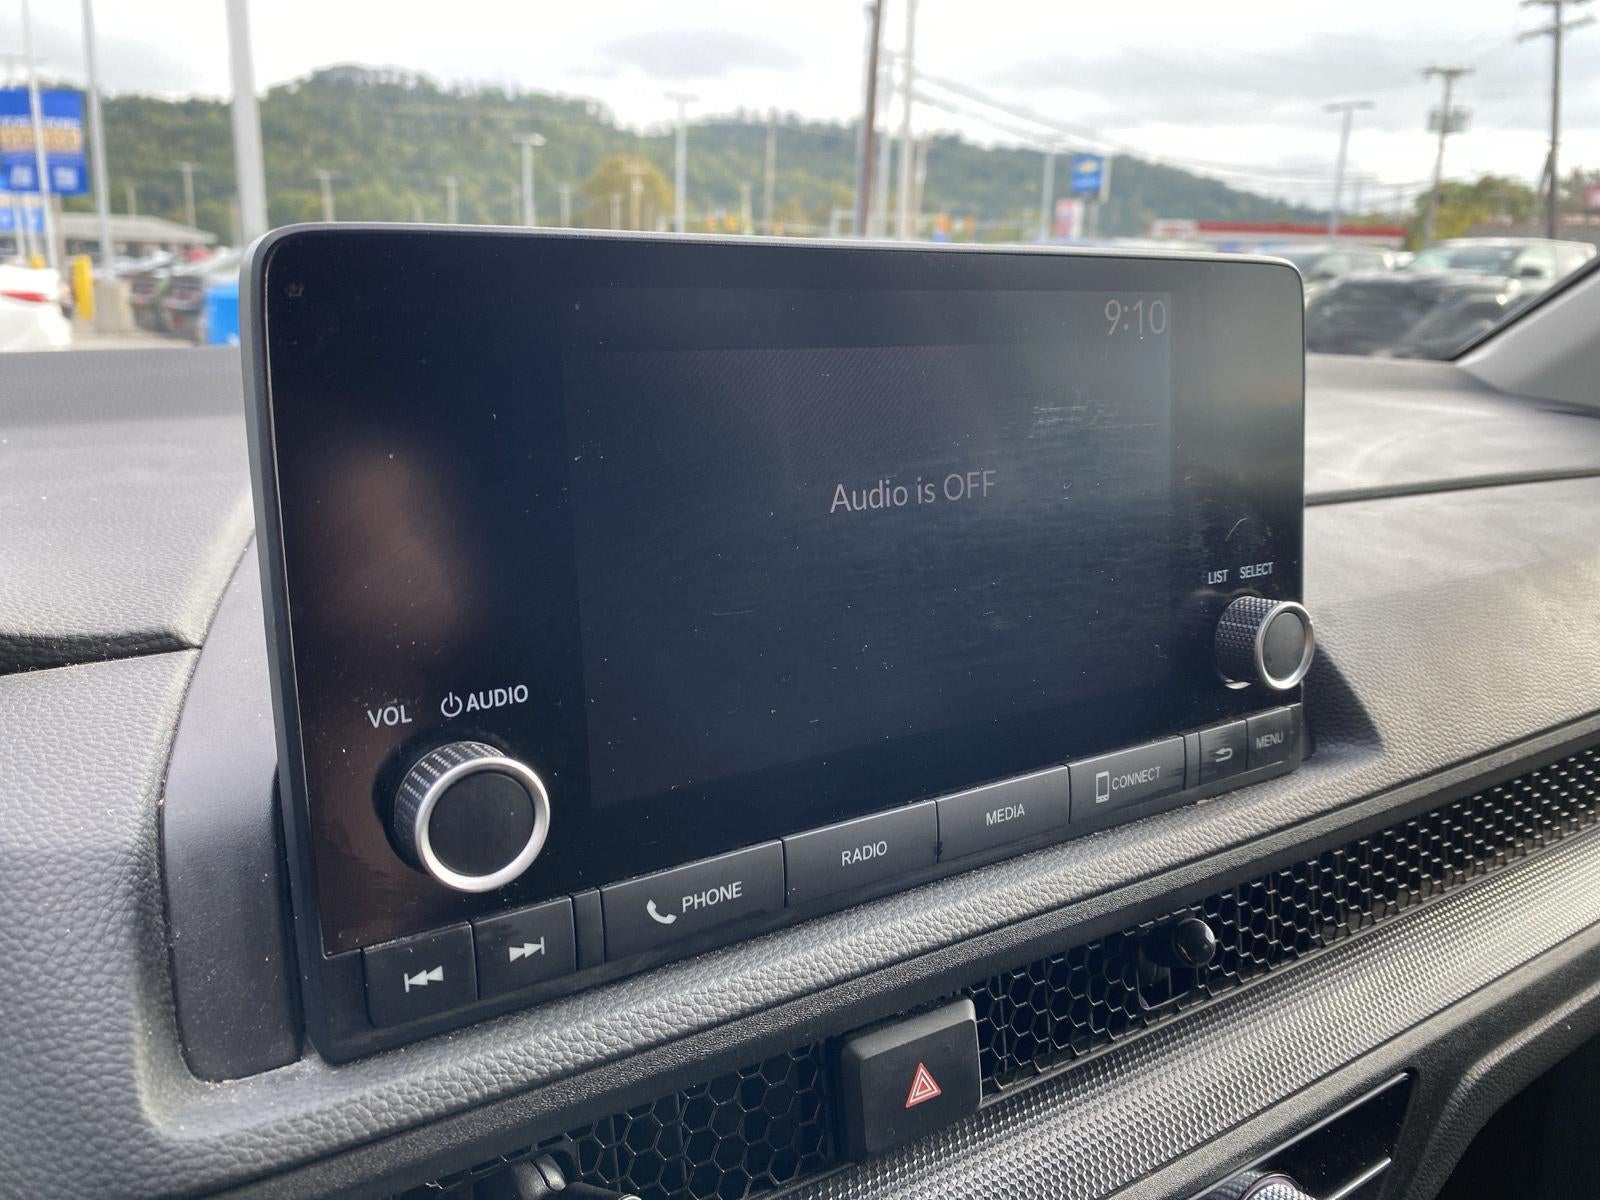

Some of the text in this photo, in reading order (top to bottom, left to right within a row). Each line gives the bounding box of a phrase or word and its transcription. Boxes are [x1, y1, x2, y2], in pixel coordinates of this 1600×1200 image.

[1104, 299, 1167, 336] 9:10
[830, 470, 996, 513] Audio is OFF
[1208, 569, 1229, 584] LIST
[1239, 562, 1274, 579] SELECT
[466, 684, 529, 712] AUDIO
[367, 705, 412, 729] VOL
[1255, 731, 1284, 749] MENU
[1111, 766, 1161, 791] CONNECT
[985, 803, 1025, 826] MEDIA
[841, 840, 887, 866] RADIO
[681, 880, 742, 913] PHONE
